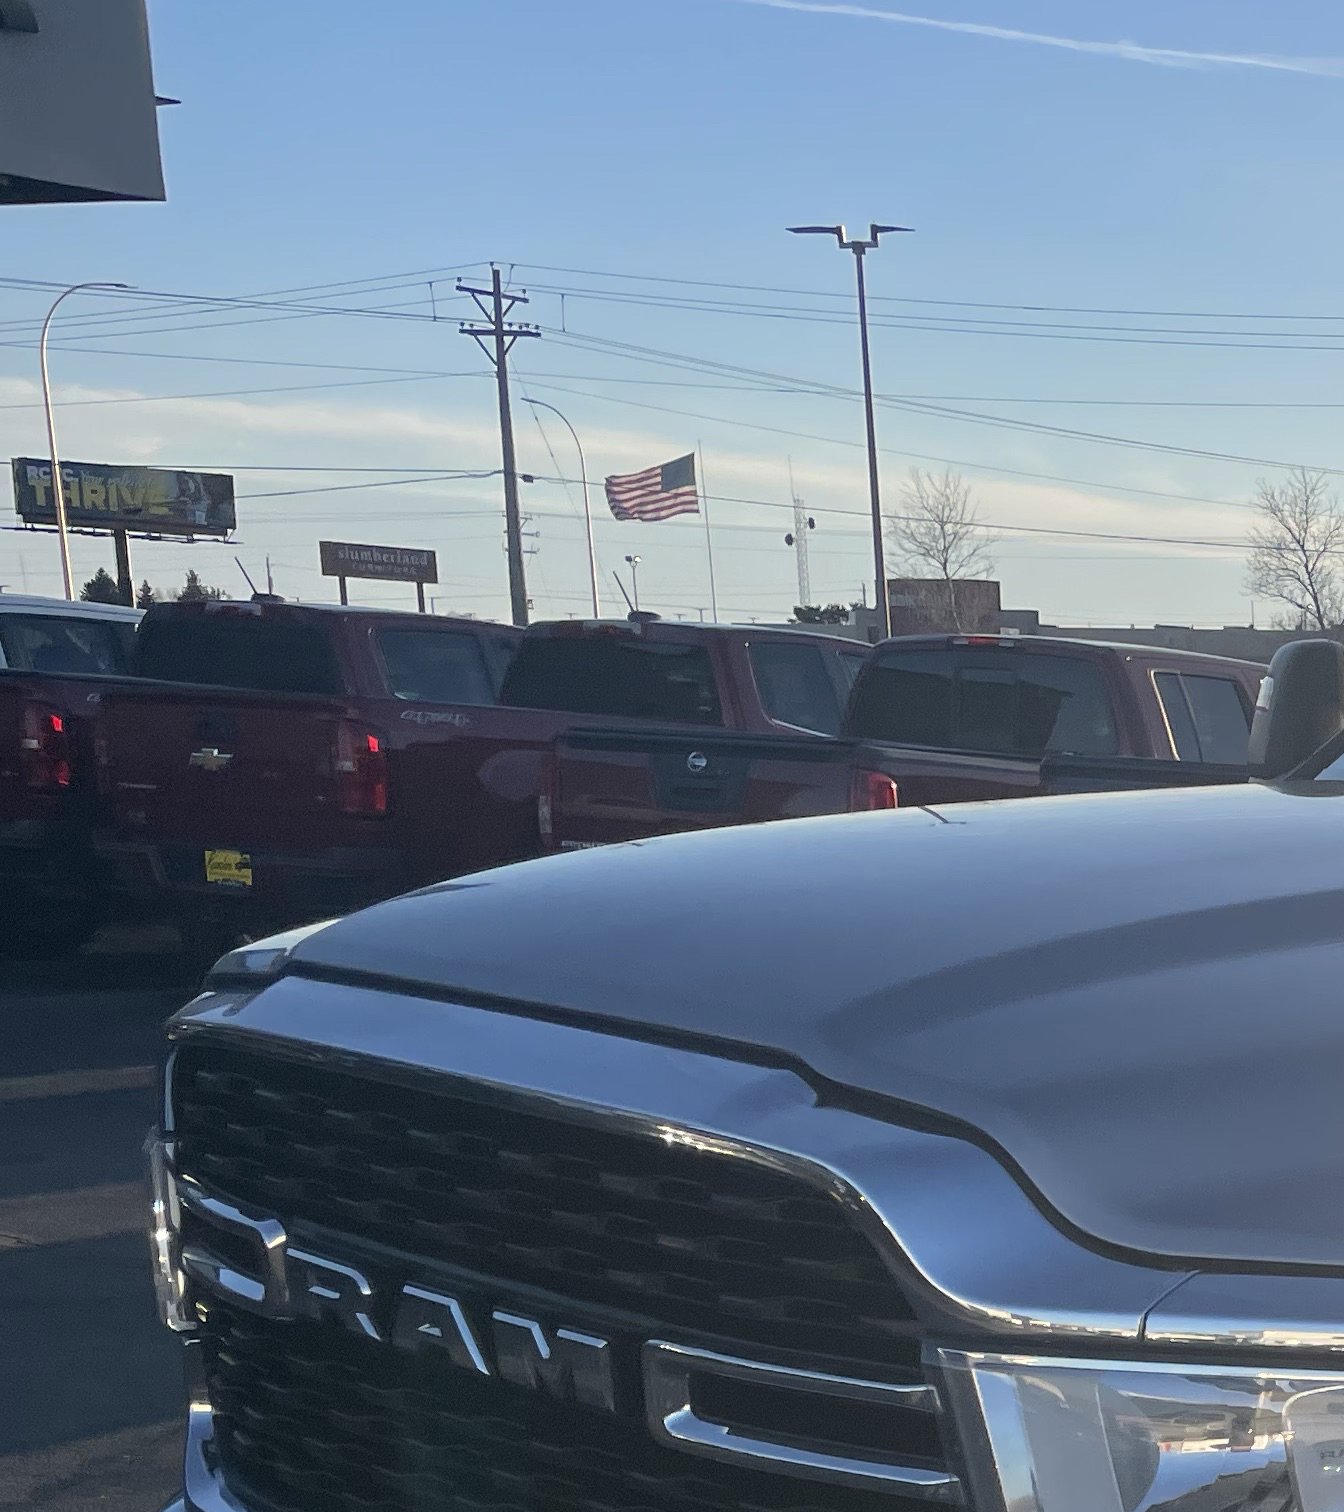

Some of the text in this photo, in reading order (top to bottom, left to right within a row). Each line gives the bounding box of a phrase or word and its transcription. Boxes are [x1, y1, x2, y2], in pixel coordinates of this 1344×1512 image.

[27, 465, 79, 482] RCC
[338, 545, 429, 566] slumberland
[285, 1246, 616, 1414] RAM
